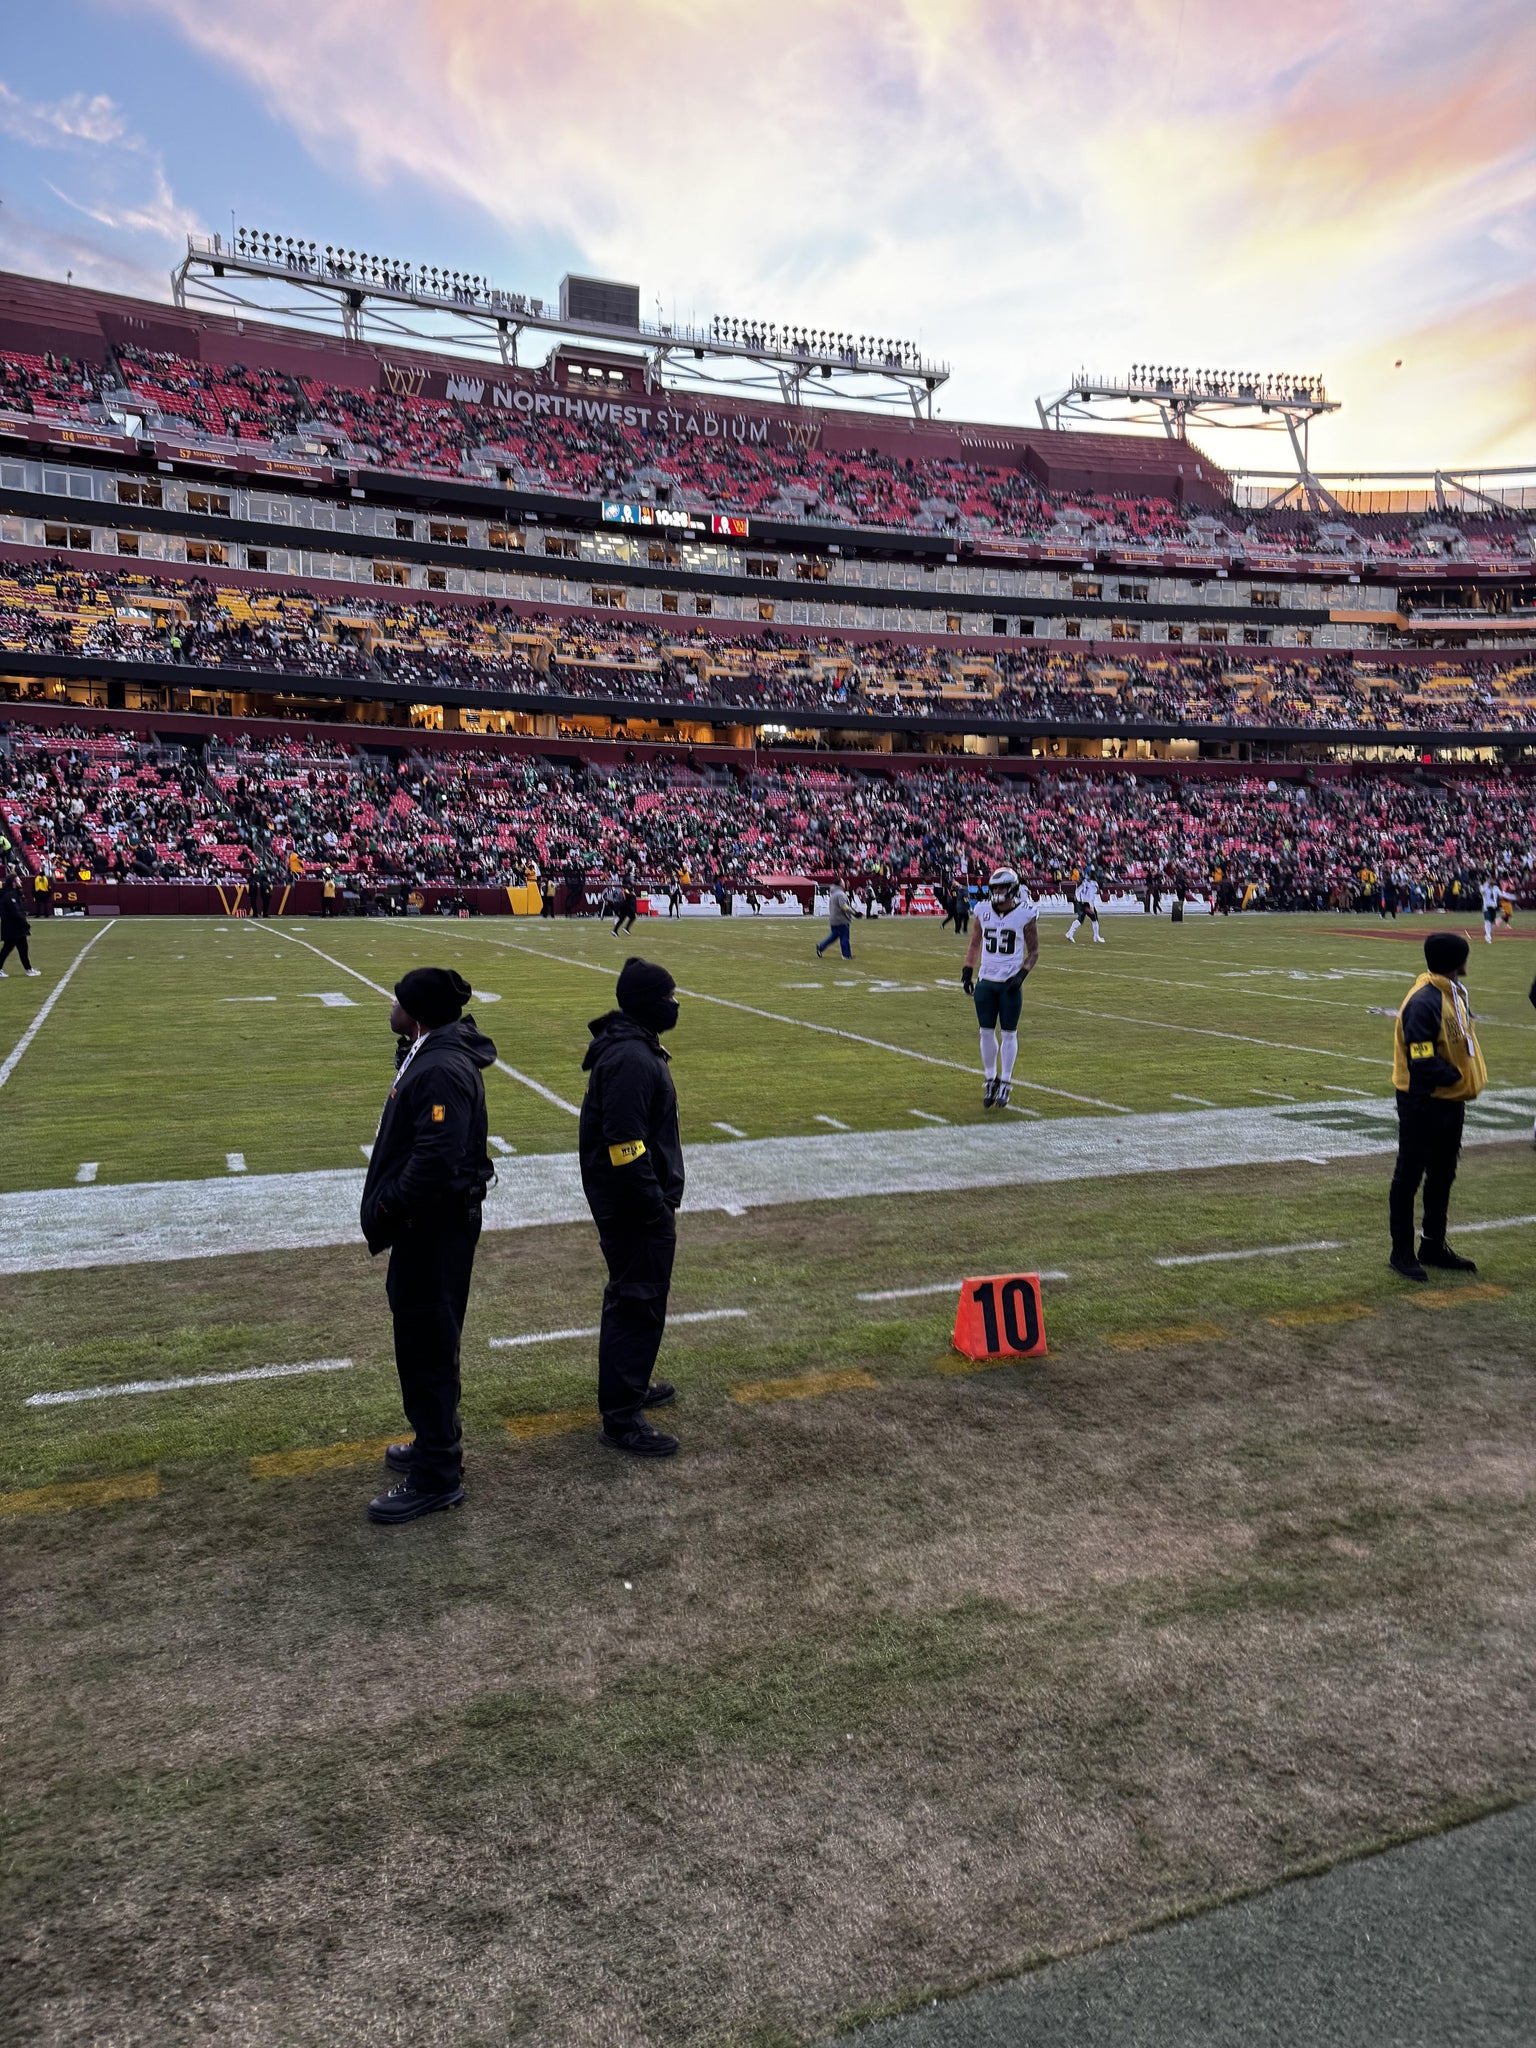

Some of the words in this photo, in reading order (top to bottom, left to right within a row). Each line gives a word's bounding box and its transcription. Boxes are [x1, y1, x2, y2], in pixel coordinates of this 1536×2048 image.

[493, 386, 652, 428] NORTHWEST
[657, 409, 769, 442] STADIUM
[984, 928, 1017, 955] 53
[973, 1279, 1040, 1353] 10
